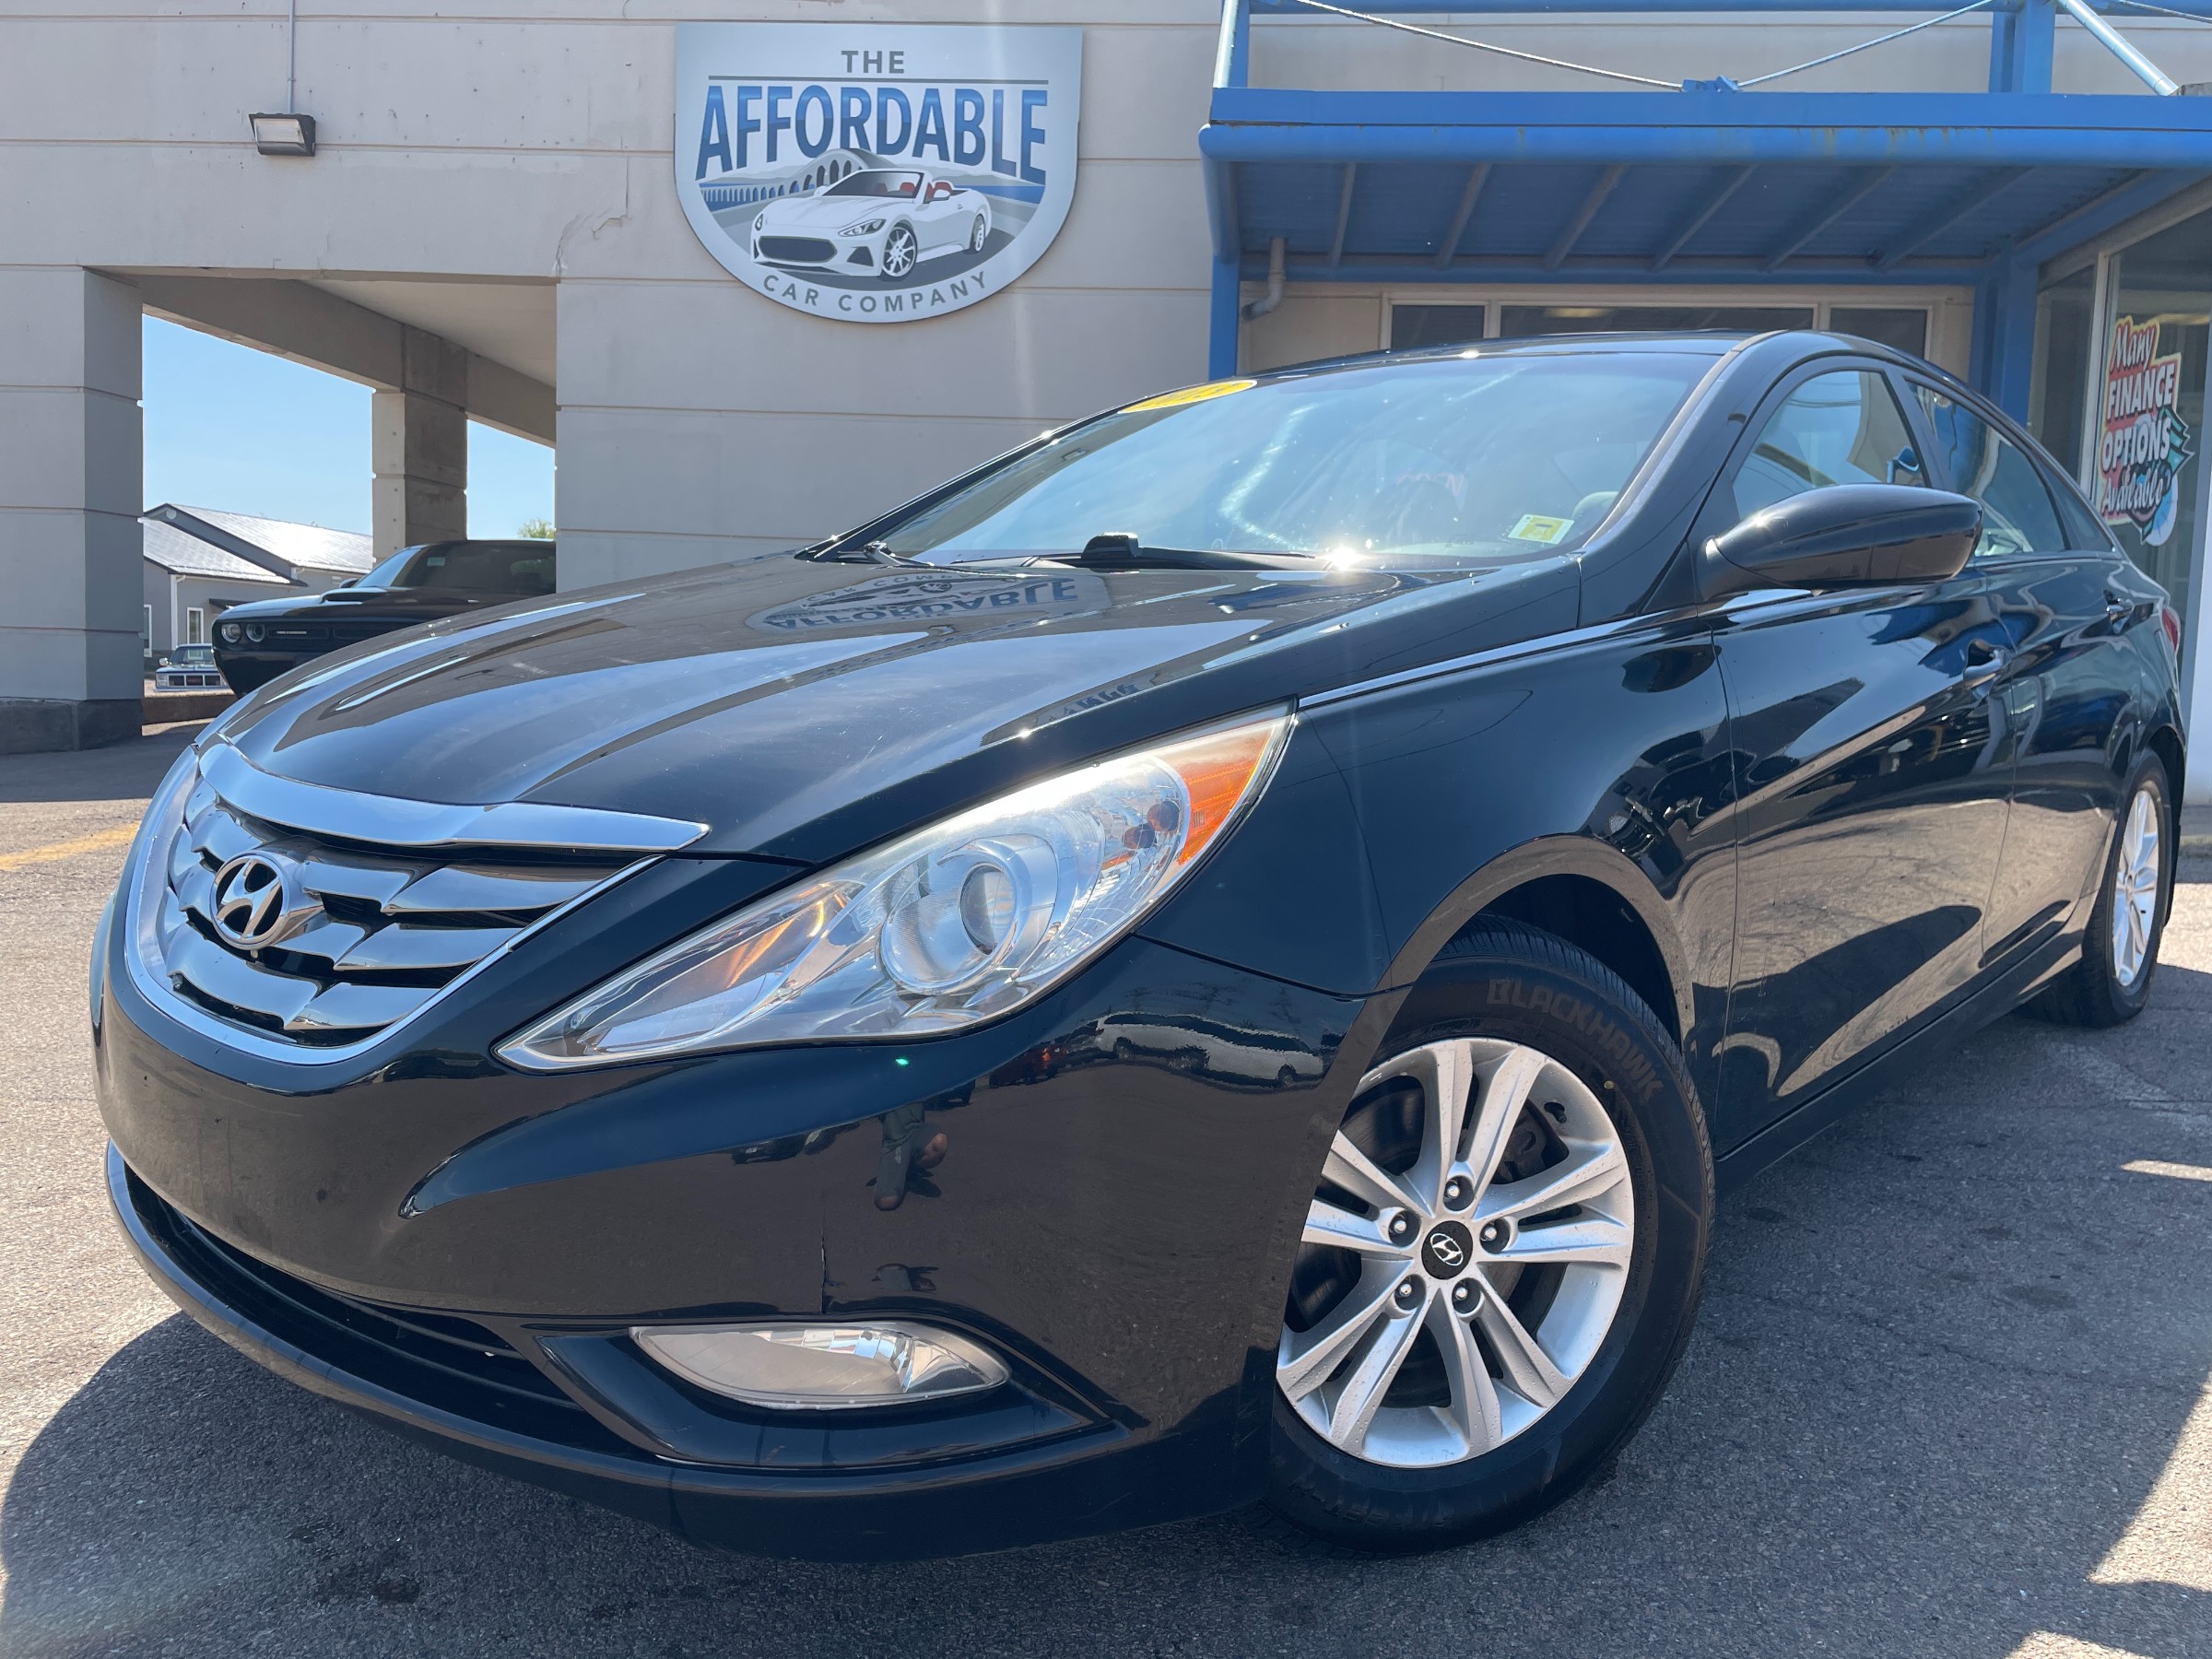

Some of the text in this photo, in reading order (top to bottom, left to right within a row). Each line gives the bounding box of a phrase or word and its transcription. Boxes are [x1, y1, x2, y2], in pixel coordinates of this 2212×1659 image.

[841, 51, 904, 74] THE
[695, 85, 1048, 185] AFFORDABLE
[763, 271, 986, 312] CAR COMPANY
[2111, 325, 2155, 370] Many
[2107, 364, 2174, 419] FINANCE
[2102, 418, 2171, 471] OPTIONS
[2103, 465, 2164, 514] Available
[1487, 978, 1663, 1100] BLACKHAWK
